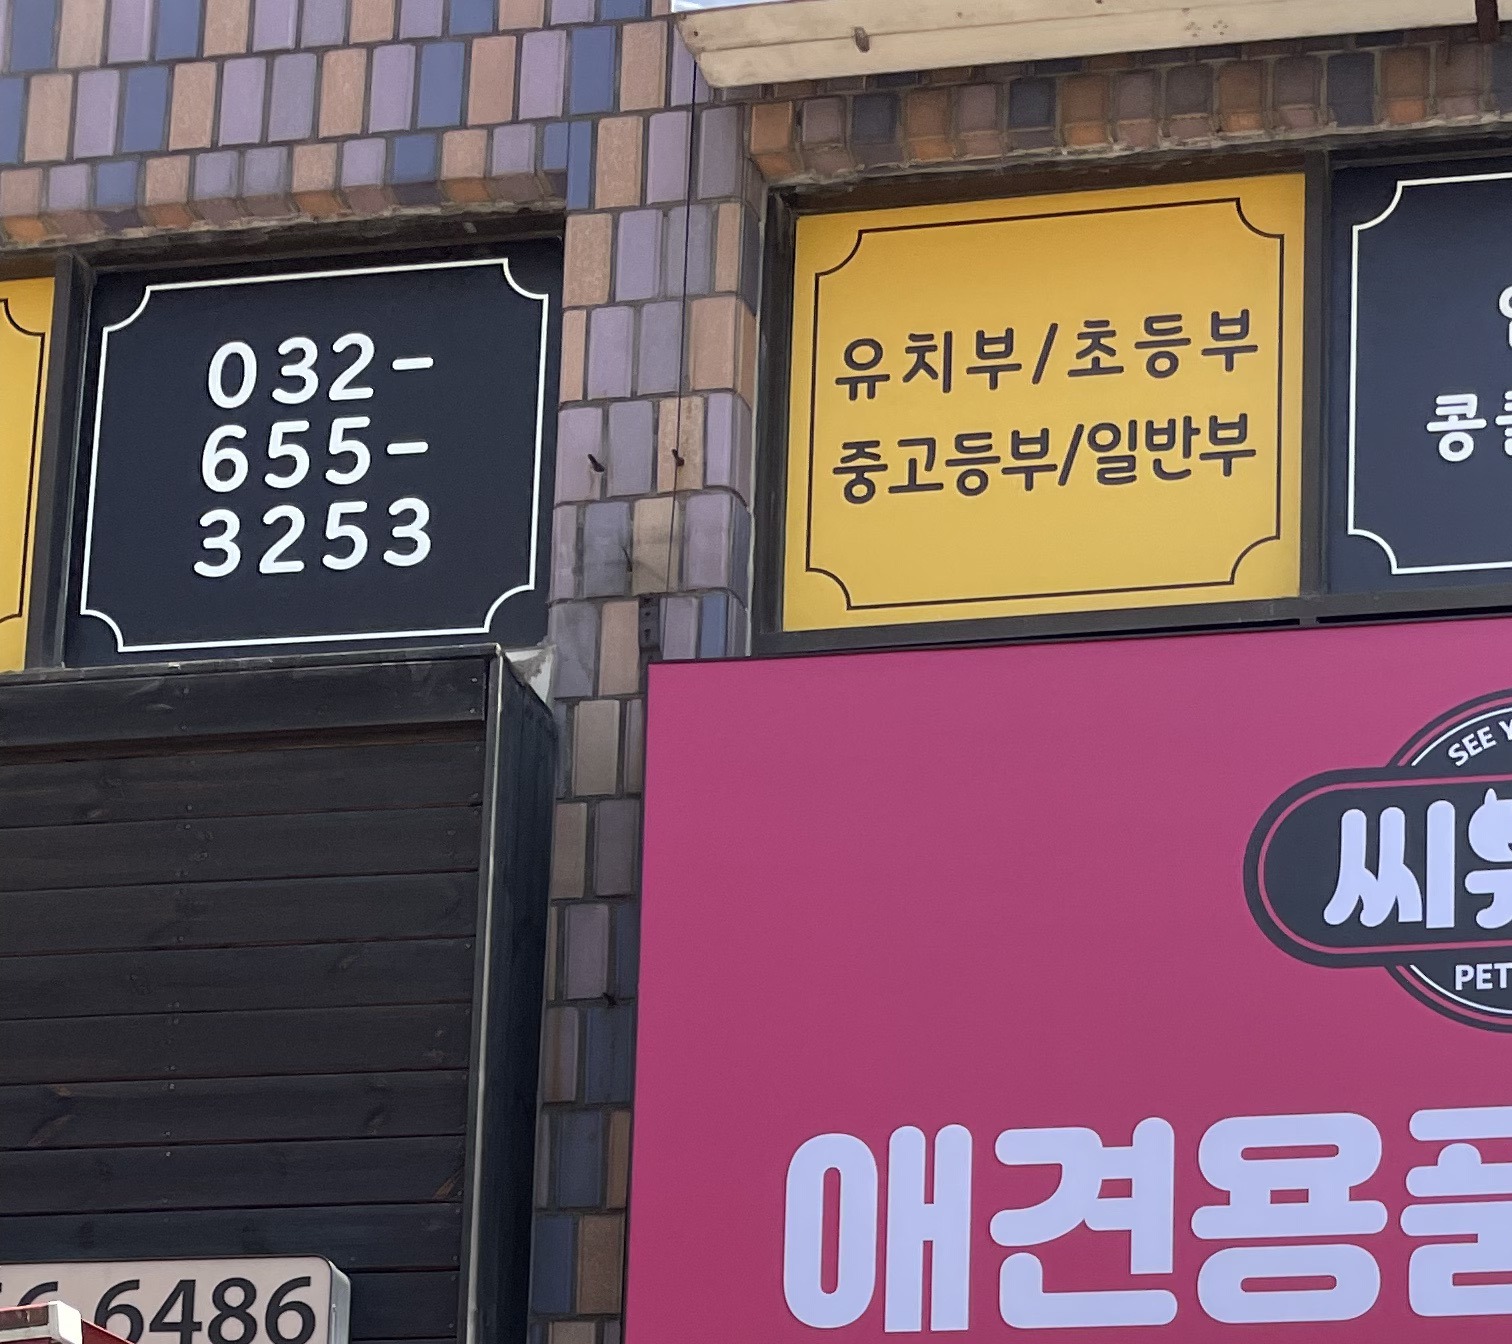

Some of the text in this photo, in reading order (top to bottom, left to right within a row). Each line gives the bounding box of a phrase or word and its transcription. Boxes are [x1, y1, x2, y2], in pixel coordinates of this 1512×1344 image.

[207, 332, 434, 409] 032-
[833, 307, 1261, 401] 유치부/초등부
[201, 416, 430, 493] 655-
[831, 412, 1257, 505] 중고등부/일반부
[194, 498, 432, 578] 3253
[1447, 726, 1497, 767] SEE
[1455, 960, 1512, 991] PET
